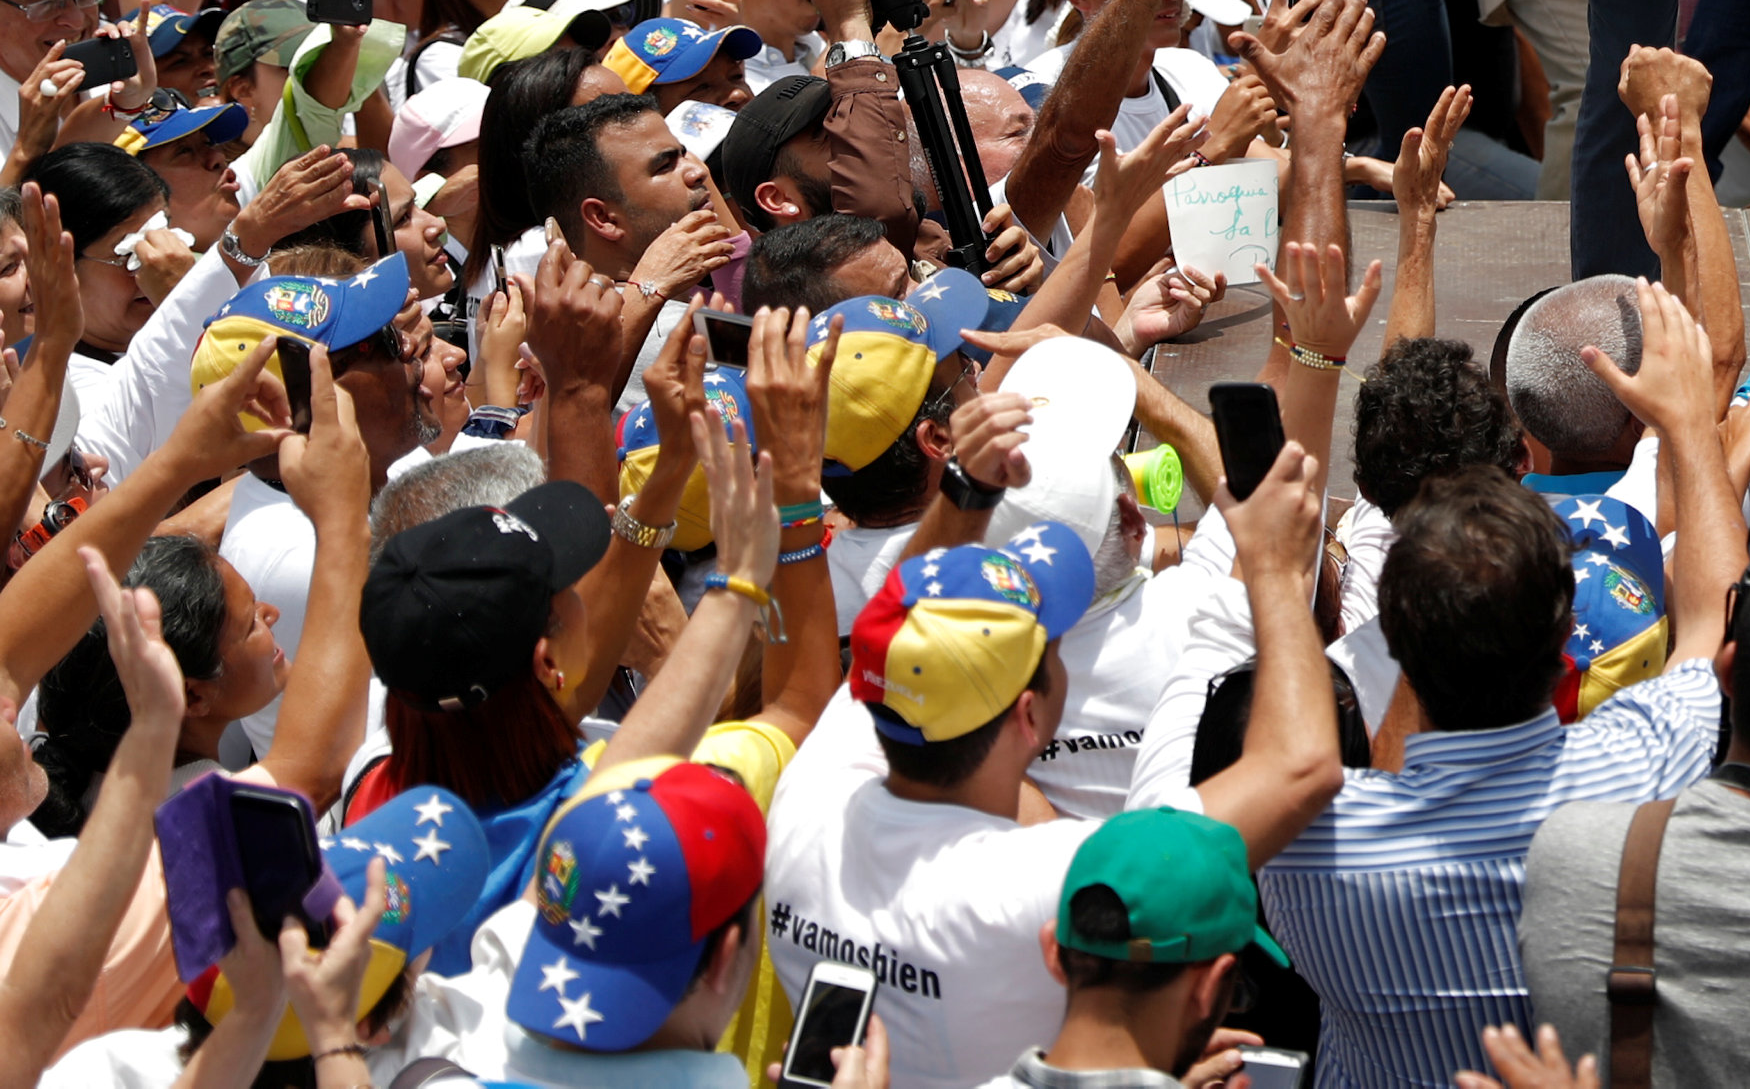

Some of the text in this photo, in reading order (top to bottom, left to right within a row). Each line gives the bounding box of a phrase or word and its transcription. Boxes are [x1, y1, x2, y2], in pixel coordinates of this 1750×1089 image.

[924, 148, 944, 202] Manfrotto
[1038, 727, 1145, 762] #vamo
[771, 902, 941, 1000] #vamosbien
